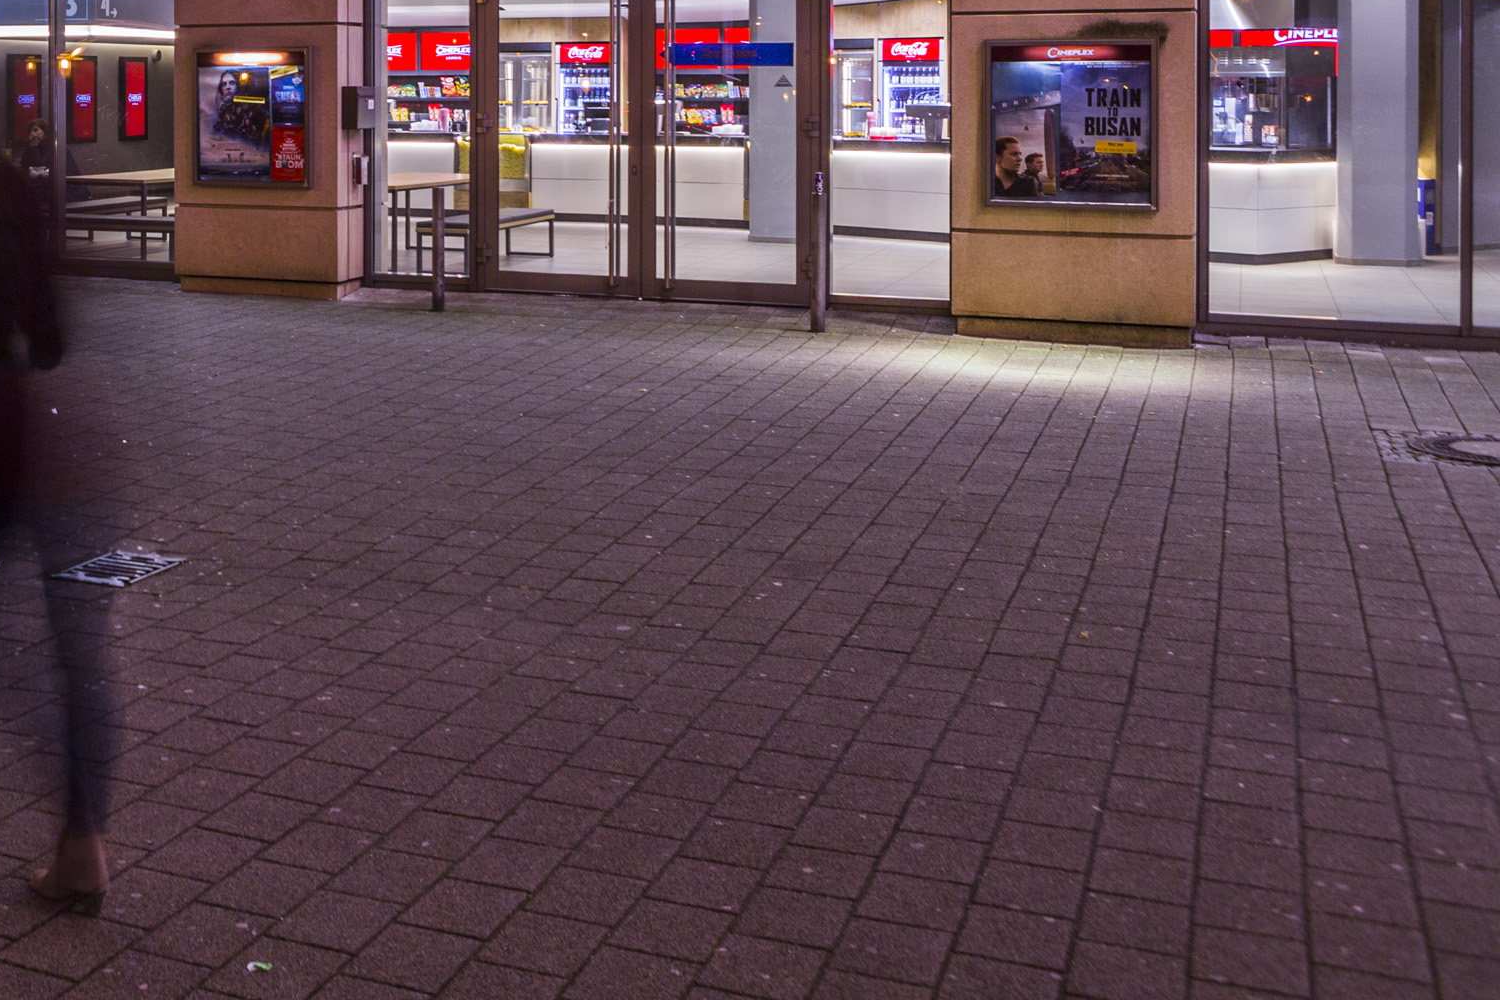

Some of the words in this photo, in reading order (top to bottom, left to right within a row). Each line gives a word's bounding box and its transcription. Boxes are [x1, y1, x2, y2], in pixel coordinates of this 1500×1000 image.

[1273, 28, 1338, 42] CINEPL
[568, 46, 605, 59] Coca-Cola
[722, 49, 758, 59] asse
[890, 41, 930, 56] Coca-Cola
[1047, 47, 1094, 58] CINEPLEX
[1085, 88, 1141, 108] TRAIN
[1107, 108, 1118, 117] TO
[1084, 117, 1141, 136] BUSAN
[275, 160, 304, 169] BOM
